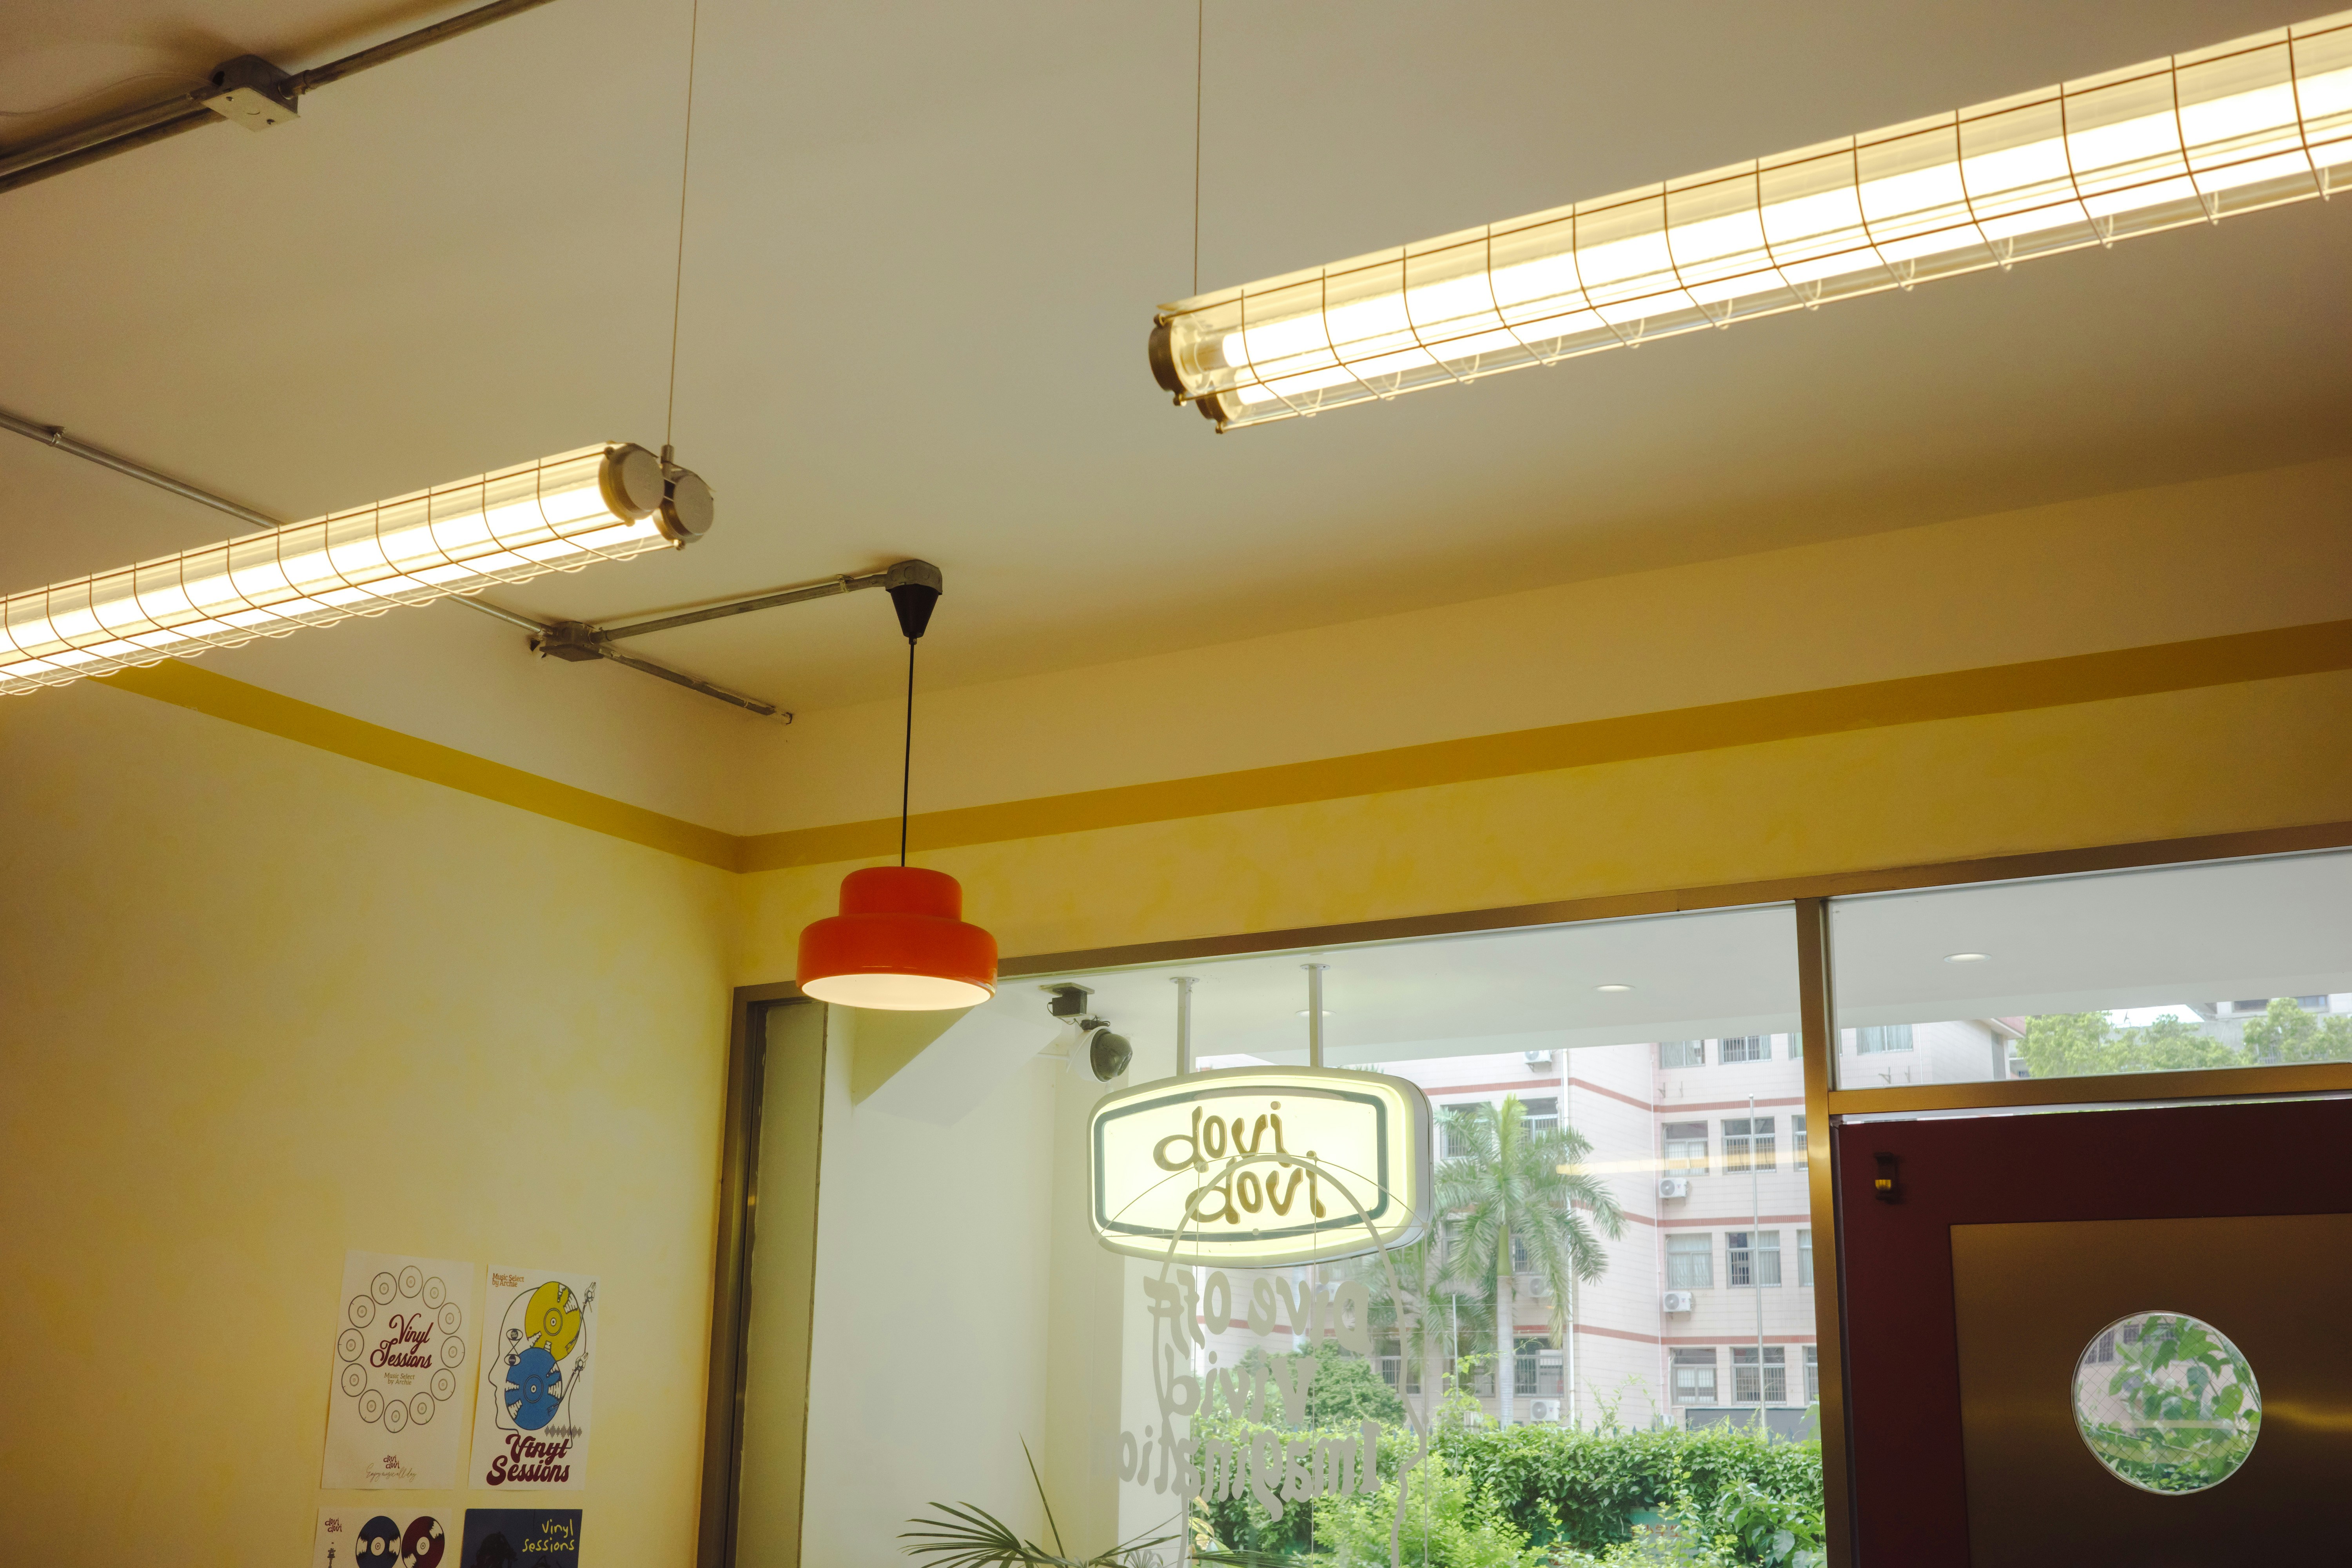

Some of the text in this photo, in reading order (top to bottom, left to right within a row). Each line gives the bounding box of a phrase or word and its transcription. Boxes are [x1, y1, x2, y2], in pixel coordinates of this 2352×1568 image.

[1153, 1101, 1292, 1173] dovi
[1185, 1150, 1326, 1225] dovi
[492, 1278, 517, 1287] by Archie
[389, 1313, 434, 1355] Vinyl
[370, 1338, 432, 1369] Sessions
[383, 1454, 397, 1463] dovi
[385, 1461, 400, 1469] dovi
[505, 1434, 570, 1466] Vinyl
[486, 1455, 570, 1486] Sessions
[325, 1517, 339, 1526] dovi
[327, 1524, 342, 1533] dovi
